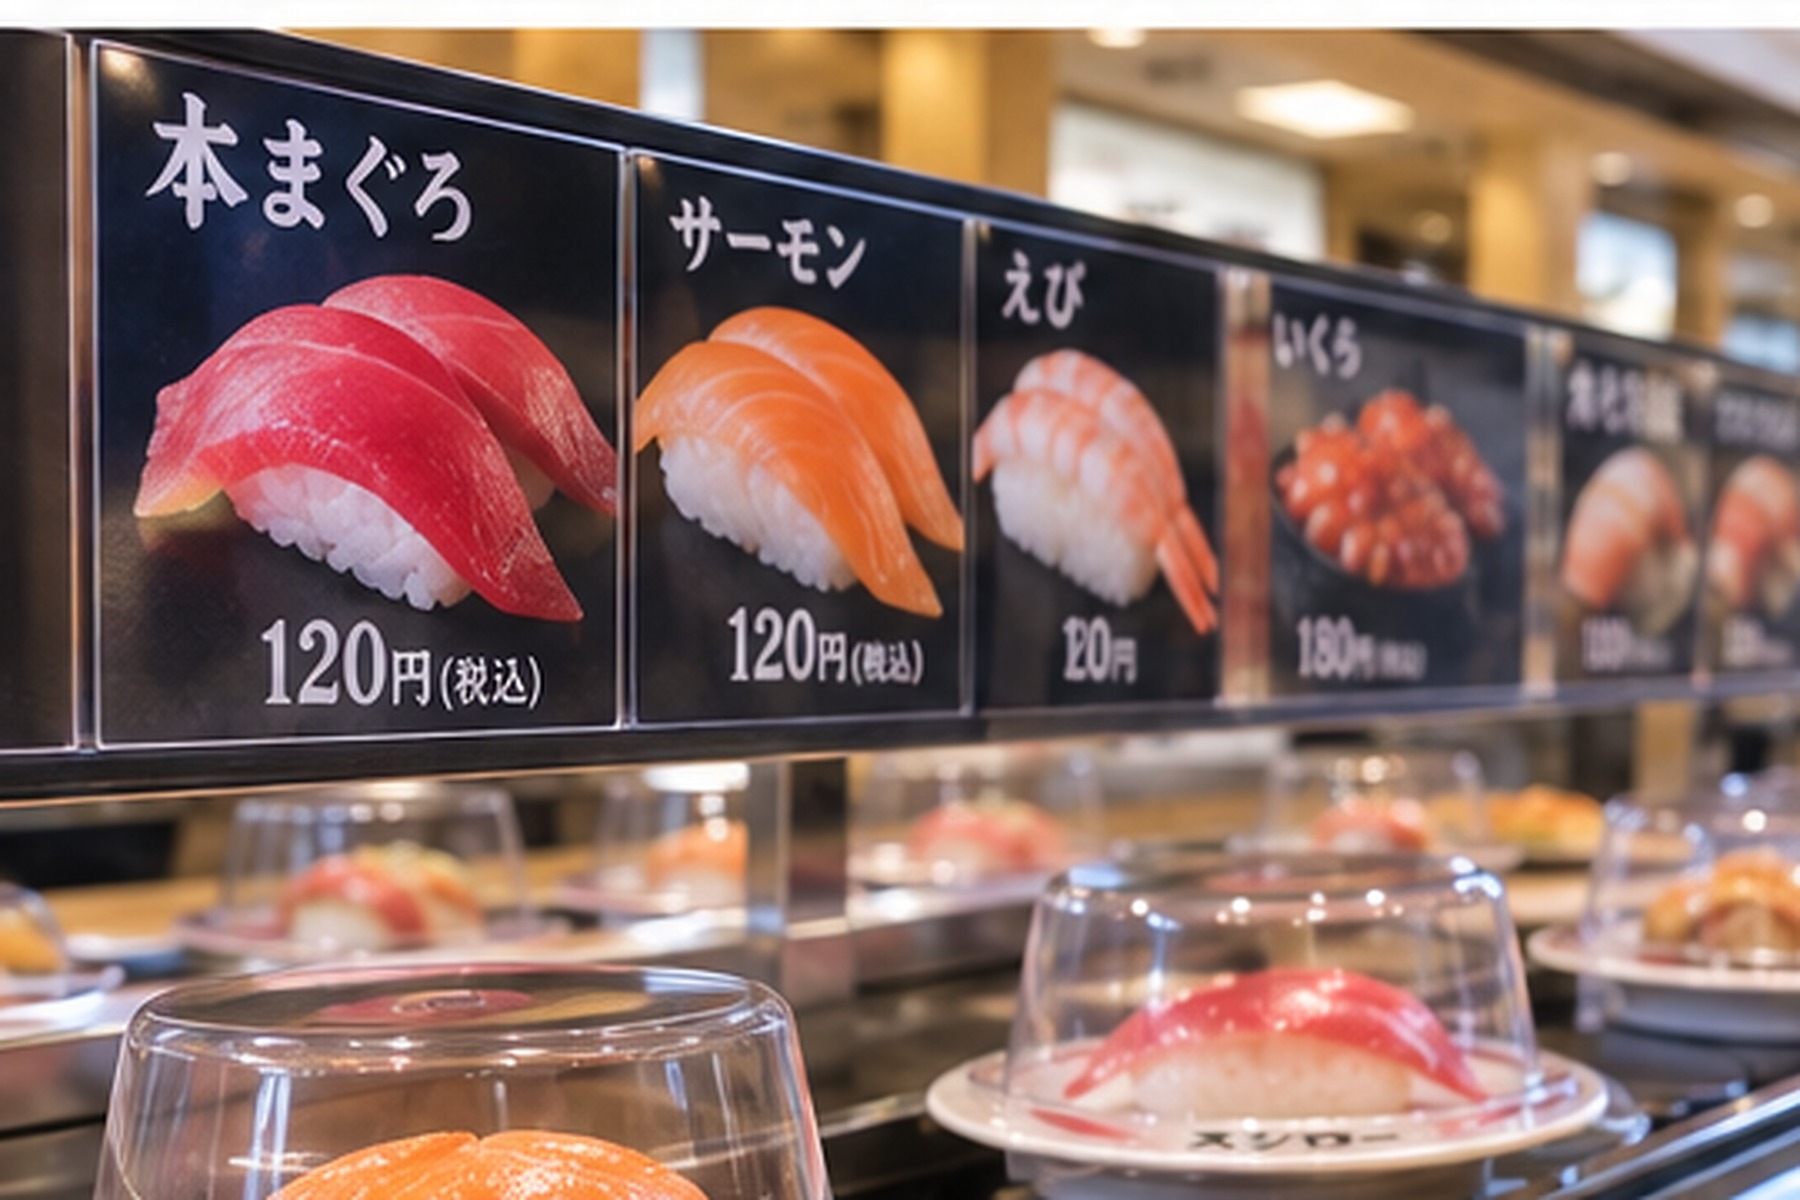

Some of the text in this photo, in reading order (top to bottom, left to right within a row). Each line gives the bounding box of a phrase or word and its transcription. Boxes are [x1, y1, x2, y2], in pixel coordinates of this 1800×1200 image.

[146, 92, 472, 241] 本まぐろ
[669, 195, 866, 289] サーモン
[1002, 249, 1087, 329] えび
[1272, 312, 1362, 379] いくら
[1062, 615, 1137, 685] 120円
